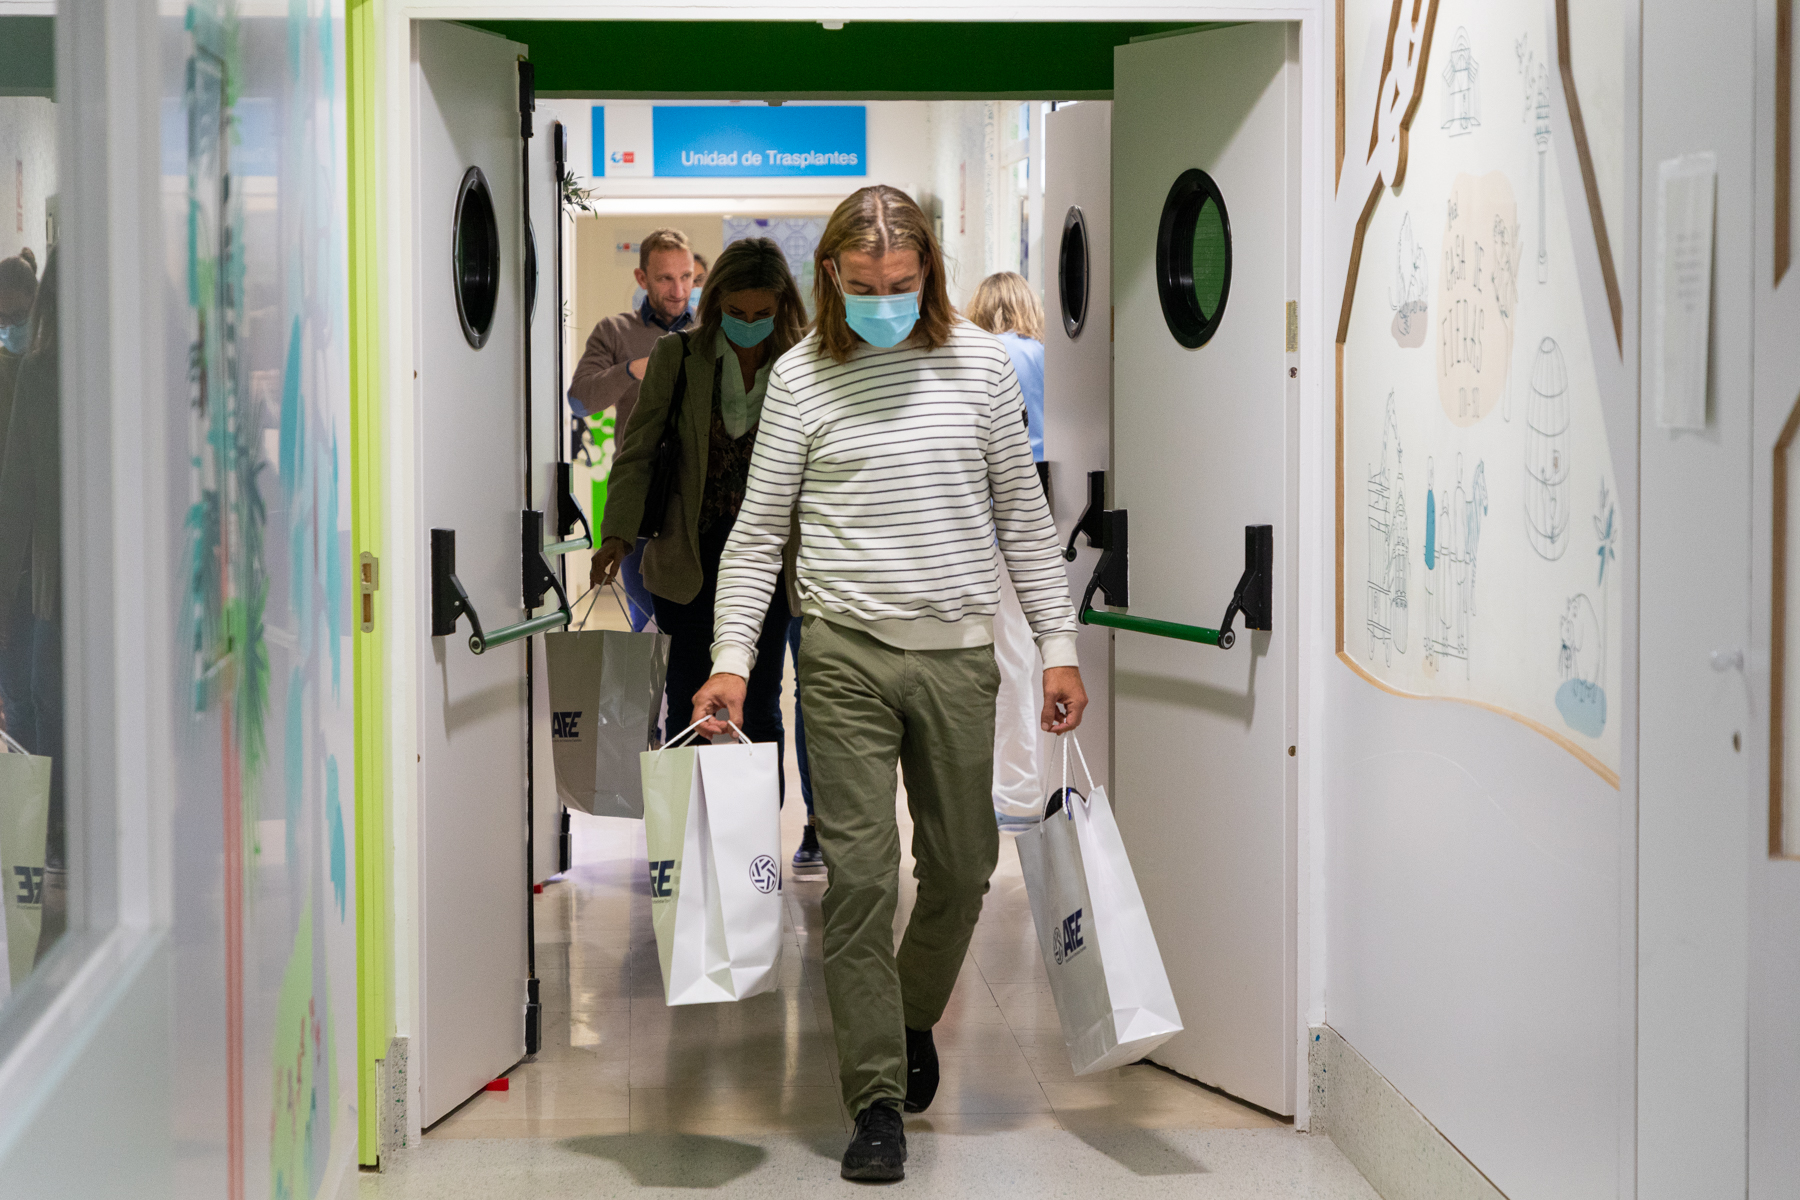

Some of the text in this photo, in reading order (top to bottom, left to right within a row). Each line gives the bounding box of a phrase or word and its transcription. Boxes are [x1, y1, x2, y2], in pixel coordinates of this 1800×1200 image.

[681, 150, 858, 169] Unidad de Trasplantes
[552, 711, 582, 738] AFE
[649, 860, 675, 898] FE
[1062, 908, 1083, 957] AFE
